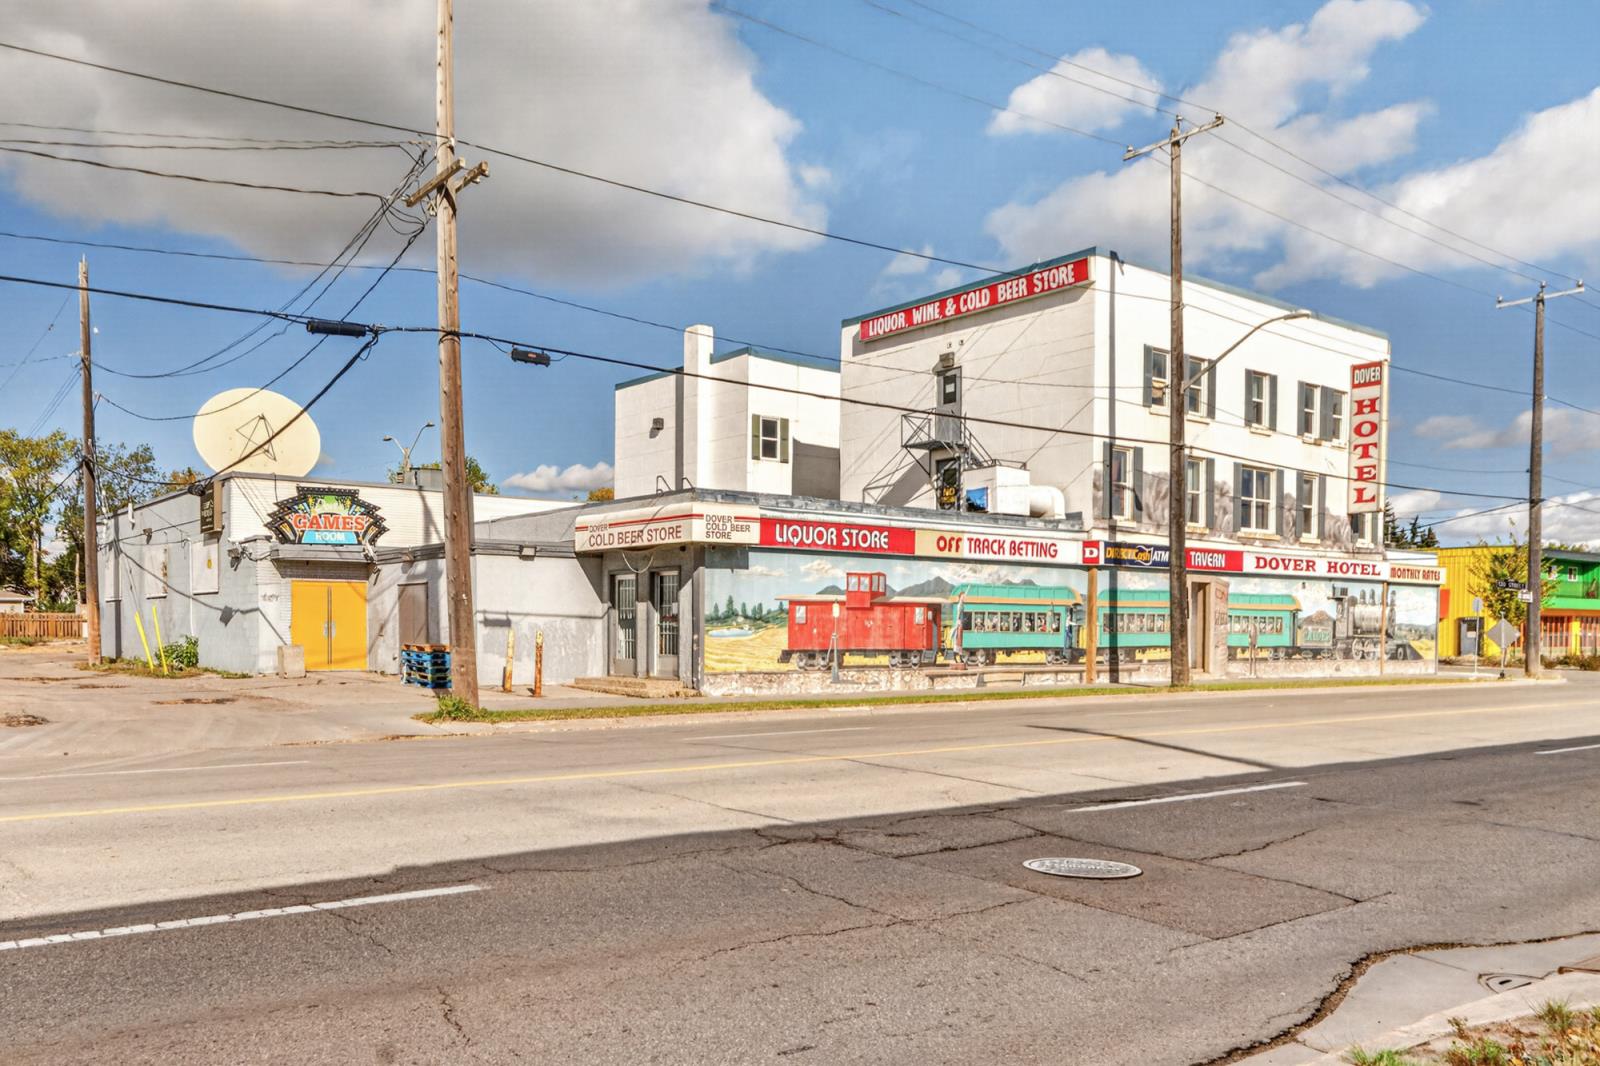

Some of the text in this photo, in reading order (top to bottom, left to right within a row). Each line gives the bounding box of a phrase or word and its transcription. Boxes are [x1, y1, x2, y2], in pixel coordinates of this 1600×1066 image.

[868, 264, 1075, 336] LIQUOR, WINE, & COLD BEER STORE
[1353, 366, 1381, 385] DOVER
[1352, 397, 1380, 504] HOTEL
[292, 513, 366, 531] GAMES
[705, 514, 733, 523] DOVER
[315, 531, 346, 541] ROOM
[588, 525, 682, 547] COLD BEER STORE
[589, 523, 608, 533] DOVER
[705, 522, 751, 533] COLD BEER
[705, 530, 732, 540] STORE
[775, 523, 889, 549] LIQUOR STORE
[936, 535, 1058, 559] OFF TRACK BETTING
[1084, 547, 1099, 558] D
[1152, 550, 1170, 562] ATM
[1189, 551, 1226, 568] TAVERN
[1254, 556, 1382, 577] DOVER HOTEL
[1390, 567, 1441, 581] MONTHLY RATES
